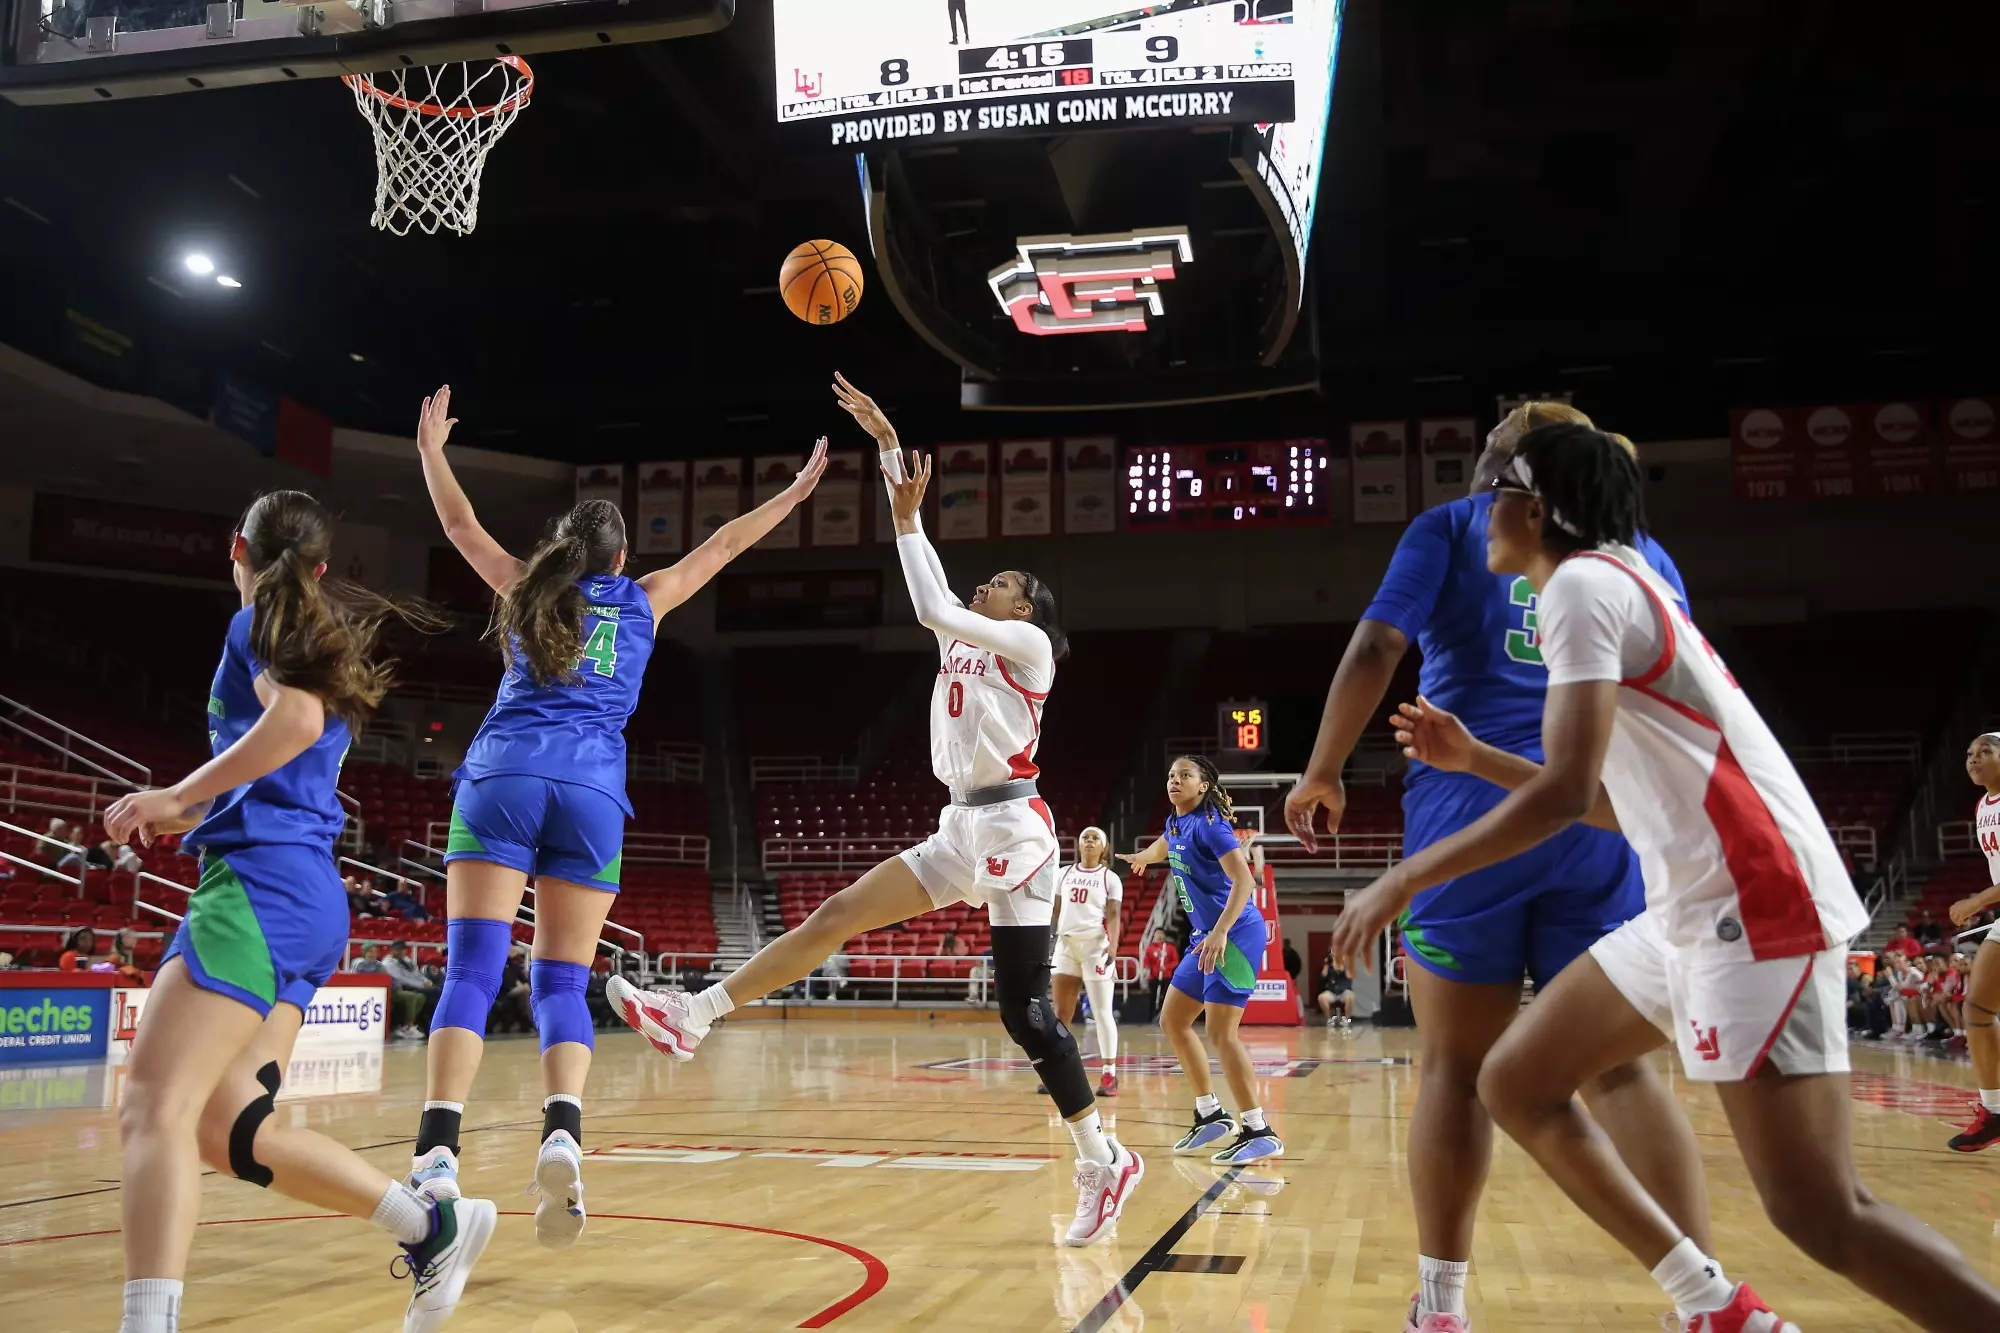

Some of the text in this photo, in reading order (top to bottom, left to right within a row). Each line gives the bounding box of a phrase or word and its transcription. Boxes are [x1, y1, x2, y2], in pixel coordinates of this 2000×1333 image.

[985, 42, 1065, 70] 4:15
[1145, 35, 1179, 63] 9
[880, 58, 910, 86] 8
[1060, 68, 1090, 86] 18
[1101, 68, 1156, 84] TOL 4
[1201, 66, 1218, 81] 2
[1228, 64, 1292, 78] TAMCC
[961, 72, 1053, 94] 1st Period
[842, 91, 892, 109] TOL 4
[934, 86, 946, 100] 1
[783, 102, 837, 118] LAMAR
[831, 90, 1234, 146] PROVIDED BY SUSAN CONN MCCURRY
[1190, 478, 1203, 497] 8
[1266, 475, 1278, 492] 9
[948, 681, 964, 718] 0
[1238, 724, 1259, 750] 18
[1066, 878, 1100, 889] LAMAR
[1070, 887, 1089, 904] 30
[302, 997, 384, 1031] nning's
[28, 1034, 61, 1047] CREDIT
[63, 1033, 92, 1045] UNION
